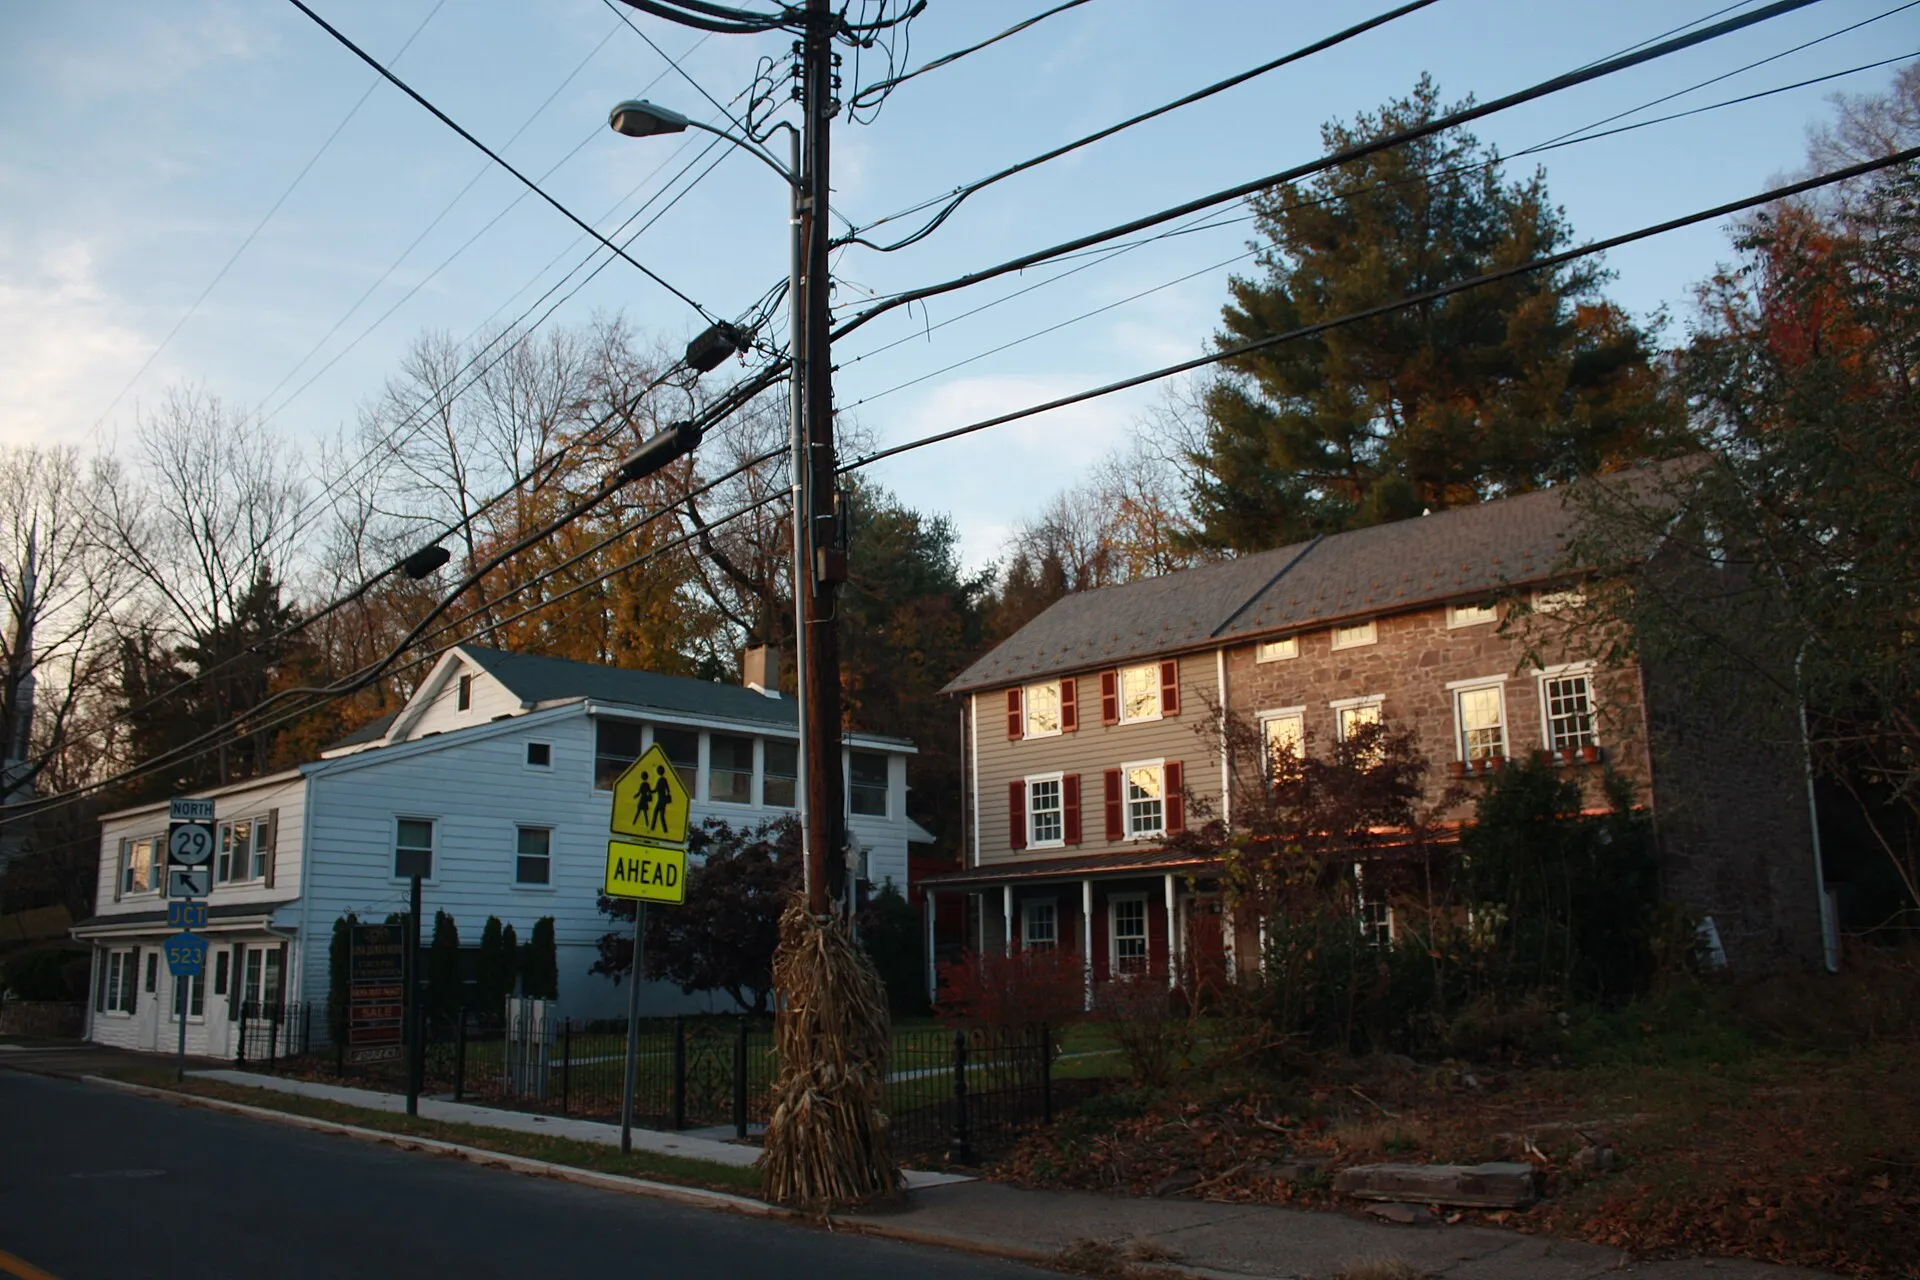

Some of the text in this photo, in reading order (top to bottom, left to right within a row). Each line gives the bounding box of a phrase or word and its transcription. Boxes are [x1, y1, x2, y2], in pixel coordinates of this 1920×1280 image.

[173, 802, 213, 817] NORTH
[177, 831, 206, 856] 29
[613, 856, 678, 887] AHEAD
[170, 906, 205, 924] JCT
[170, 948, 202, 964] 523
